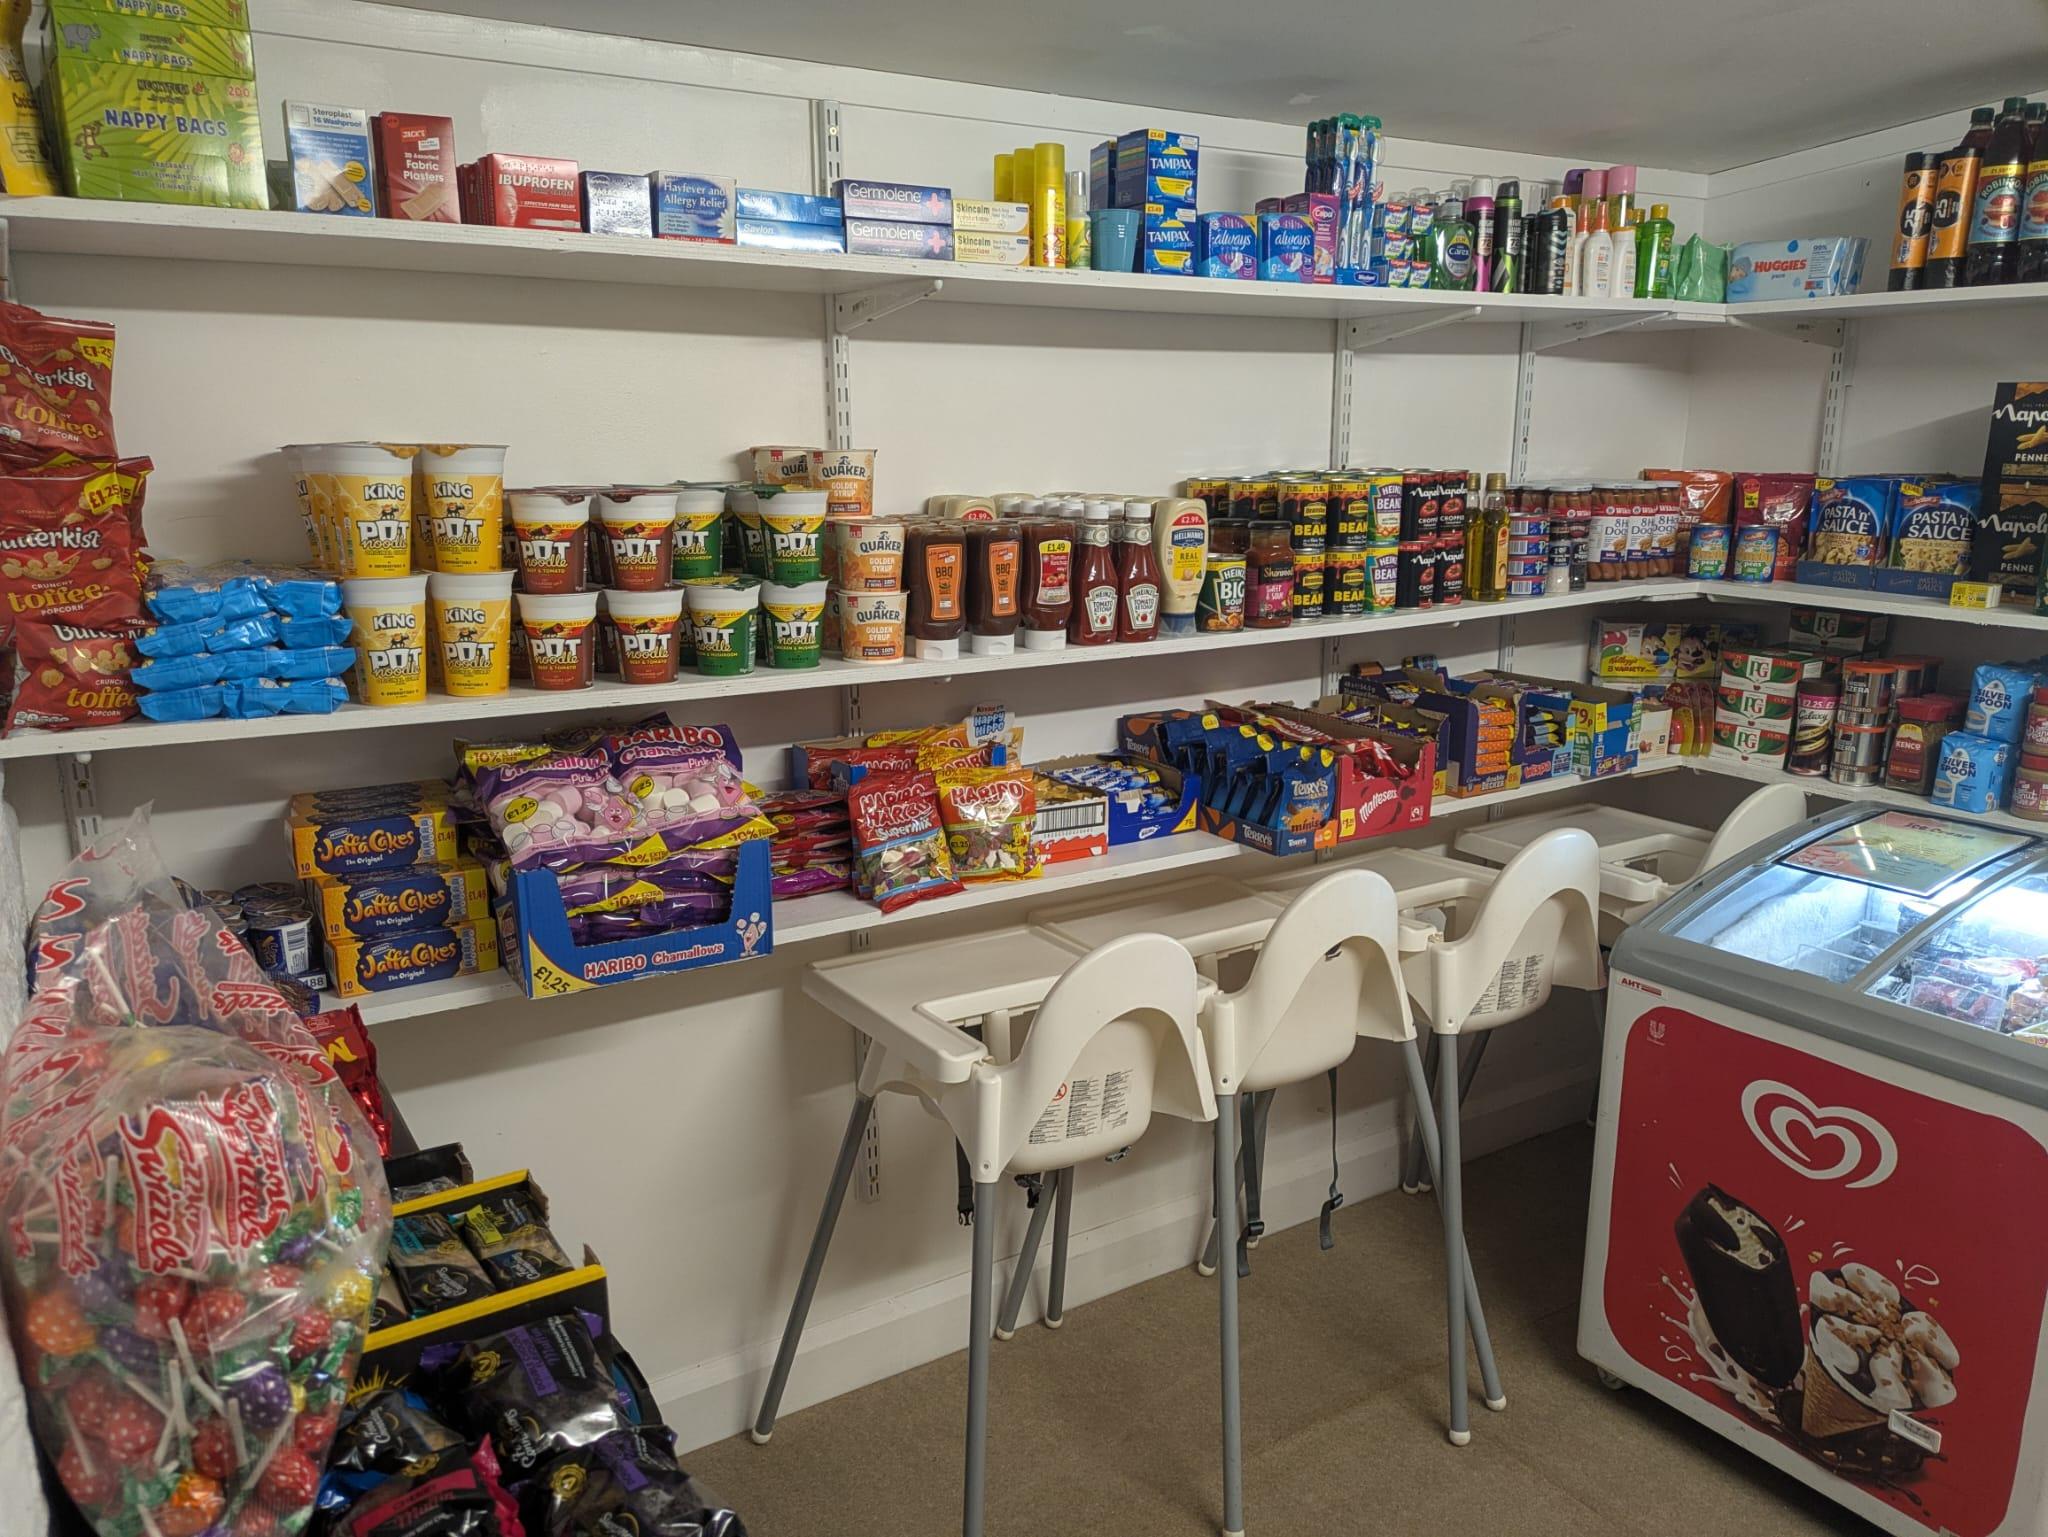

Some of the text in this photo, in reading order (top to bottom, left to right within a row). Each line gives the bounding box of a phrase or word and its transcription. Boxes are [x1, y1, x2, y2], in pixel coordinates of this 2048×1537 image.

[156, 1, 187, 16] BAGS
[123, 50, 193, 67] NAPPY BAGS
[228, 86, 250, 98] 200
[313, 108, 352, 119] Steroplast
[105, 109, 228, 137] NAPPY BAGS
[323, 118, 362, 128] Washproof
[406, 160, 439, 171] Fabric
[1151, 158, 1191, 170] TAMPAX
[403, 171, 444, 182] Plasters
[499, 175, 574, 191] IBUPROFEN
[664, 183, 725, 197] Hayfever and
[848, 183, 921, 202] Germolene
[664, 196, 726, 208] Allergy Relief
[956, 203, 990, 214] Skincalm
[1935, 199, 1948, 219] 25
[743, 223, 774, 234] Savlon
[851, 223, 924, 239] Germolene
[957, 235, 991, 246] Skincalm
[1148, 231, 1190, 242] TAMPAX
[1214, 230, 1251, 249] always
[1275, 231, 1311, 249] always
[1448, 247, 1469, 256] Carex
[1754, 259, 1807, 272] HUGGIES
[38, 427, 79, 442] POPCORN
[822, 464, 866, 478] QUAKER
[364, 483, 405, 500] KING
[432, 482, 473, 499] KING
[831, 482, 858, 490] GOLDEN
[834, 489, 856, 497] SYRUP
[89, 485, 119, 508] £1.25
[1824, 506, 1854, 520] PASTA
[1912, 511, 1955, 525] PASTA
[432, 517, 483, 537] POT
[1181, 516, 1201, 525] £2.99
[1822, 519, 1870, 535] SAUCE
[357, 518, 410, 541] POT
[1907, 525, 1973, 541] SAUCE
[612, 539, 661, 557] POT
[774, 532, 819, 550] POT
[859, 540, 902, 554] QUAKER
[1047, 543, 1065, 552] £1.49
[520, 539, 570, 560] POT
[1180, 552, 1198, 560] REAL
[524, 554, 568, 567] noodle
[615, 552, 658, 566] noodle
[869, 557, 895, 565] GOLDEN
[871, 564, 892, 572] SYRUP
[935, 566, 953, 579] BBQ
[995, 563, 1010, 576] BBQ
[2001, 563, 2034, 573] PENNE
[32, 580, 73, 590] CRUNCHY
[1136, 587, 1154, 596] HEINZ
[8, 583, 104, 613] toffee
[1095, 589, 1112, 598] HEINZ
[1134, 598, 1154, 606] TOMATO
[41, 604, 84, 616] POPCORN
[444, 607, 485, 624] KING
[856, 609, 900, 622] QUAKER
[373, 613, 415, 631] KING
[1816, 616, 1839, 634] PG
[694, 626, 734, 645] POT
[775, 621, 819, 639] POT
[866, 626, 893, 634] GOLDEN
[869, 633, 891, 641] SYRUP
[531, 638, 581, 657] POT
[623, 633, 671, 651] POT
[368, 648, 422, 668] POT
[443, 641, 496, 662] POT
[534, 651, 579, 664] noodle
[626, 646, 669, 659] noodle
[1750, 661, 1769, 678] PG
[1976, 688, 2012, 702] SILVER
[1744, 696, 1765, 714] PG
[1974, 696, 2012, 710] SPOON
[88, 709, 121, 717] POPCORN
[975, 713, 1005, 727] Happy
[1798, 710, 1829, 721] Galaxy
[975, 723, 1005, 738] Hippo
[1738, 731, 1758, 749] PG
[1895, 741, 1921, 750] KENCO
[1940, 764, 1977, 777] SPOON
[1943, 757, 1977, 770] SILVER
[1291, 779, 1328, 797] TERRY'S
[1482, 780, 1506, 791] DECKER
[951, 780, 1024, 806] HARIBO
[506, 801, 537, 820] £1.25
[866, 799, 932, 827] HARIBO
[1360, 789, 1399, 824] Maltesers
[876, 817, 932, 841] Supermix
[1291, 817, 1319, 833] minis
[1242, 824, 1273, 846] TERRY'S
[317, 829, 414, 862] Jaffa Cakes
[301, 863, 311, 872] 10
[357, 855, 384, 866] Original
[347, 888, 445, 923] Jaffa Cakes
[387, 915, 414, 926] Original
[330, 924, 340, 933] 10
[361, 943, 456, 979] Jaffa Cakes
[584, 943, 724, 980] HARIBO Chamallows
[400, 969, 425, 981] Original
[534, 966, 570, 994] £1.25
[343, 981, 353, 990] 10
[1622, 978, 1640, 989] AHT
